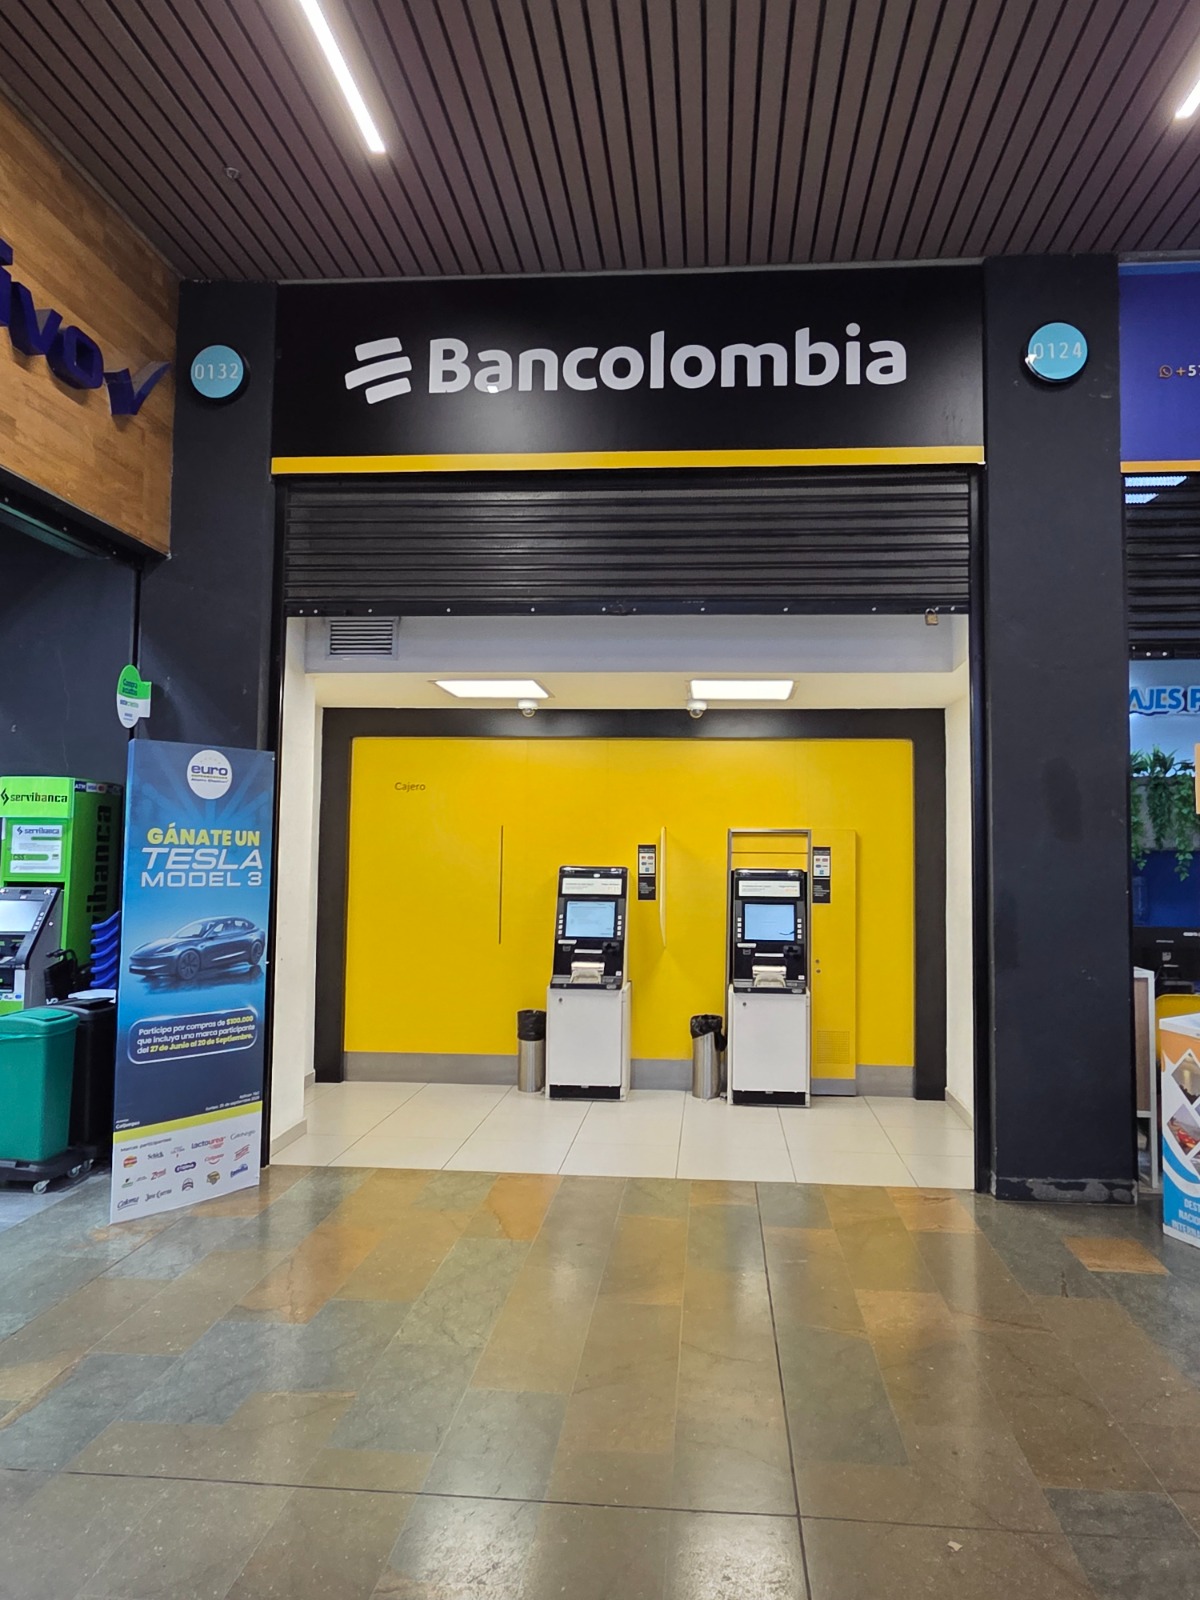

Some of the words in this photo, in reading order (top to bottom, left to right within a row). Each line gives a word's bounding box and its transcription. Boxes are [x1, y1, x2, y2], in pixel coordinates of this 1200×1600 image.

[428, 322, 907, 395] Bancolombia
[1033, 341, 1083, 359] 0124
[194, 363, 239, 380] 0132
[1176, 364, 1200, 377] +5
[191, 765, 228, 776] euro
[394, 781, 426, 793] Cajero
[10, 792, 68, 803] servibanca
[147, 821, 233, 846] GÁNATE
[234, 829, 261, 847] UN
[141, 847, 263, 870] TESLA
[141, 871, 242, 888] MODEL
[247, 871, 262, 887] 3
[139, 1025, 173, 1036] Participa
[173, 1025, 186, 1034] por
[186, 1020, 217, 1031] compras
[217, 1019, 226, 1027] de
[137, 1037, 153, 1047] que
[153, 1034, 180, 1045] incluya
[181, 1032, 195, 1040] una
[196, 1030, 218, 1038] marca
[137, 1045, 149, 1054] del
[159, 1044, 168, 1052] de
[169, 1041, 190, 1051] Junio
[206, 1038, 215, 1046] de
